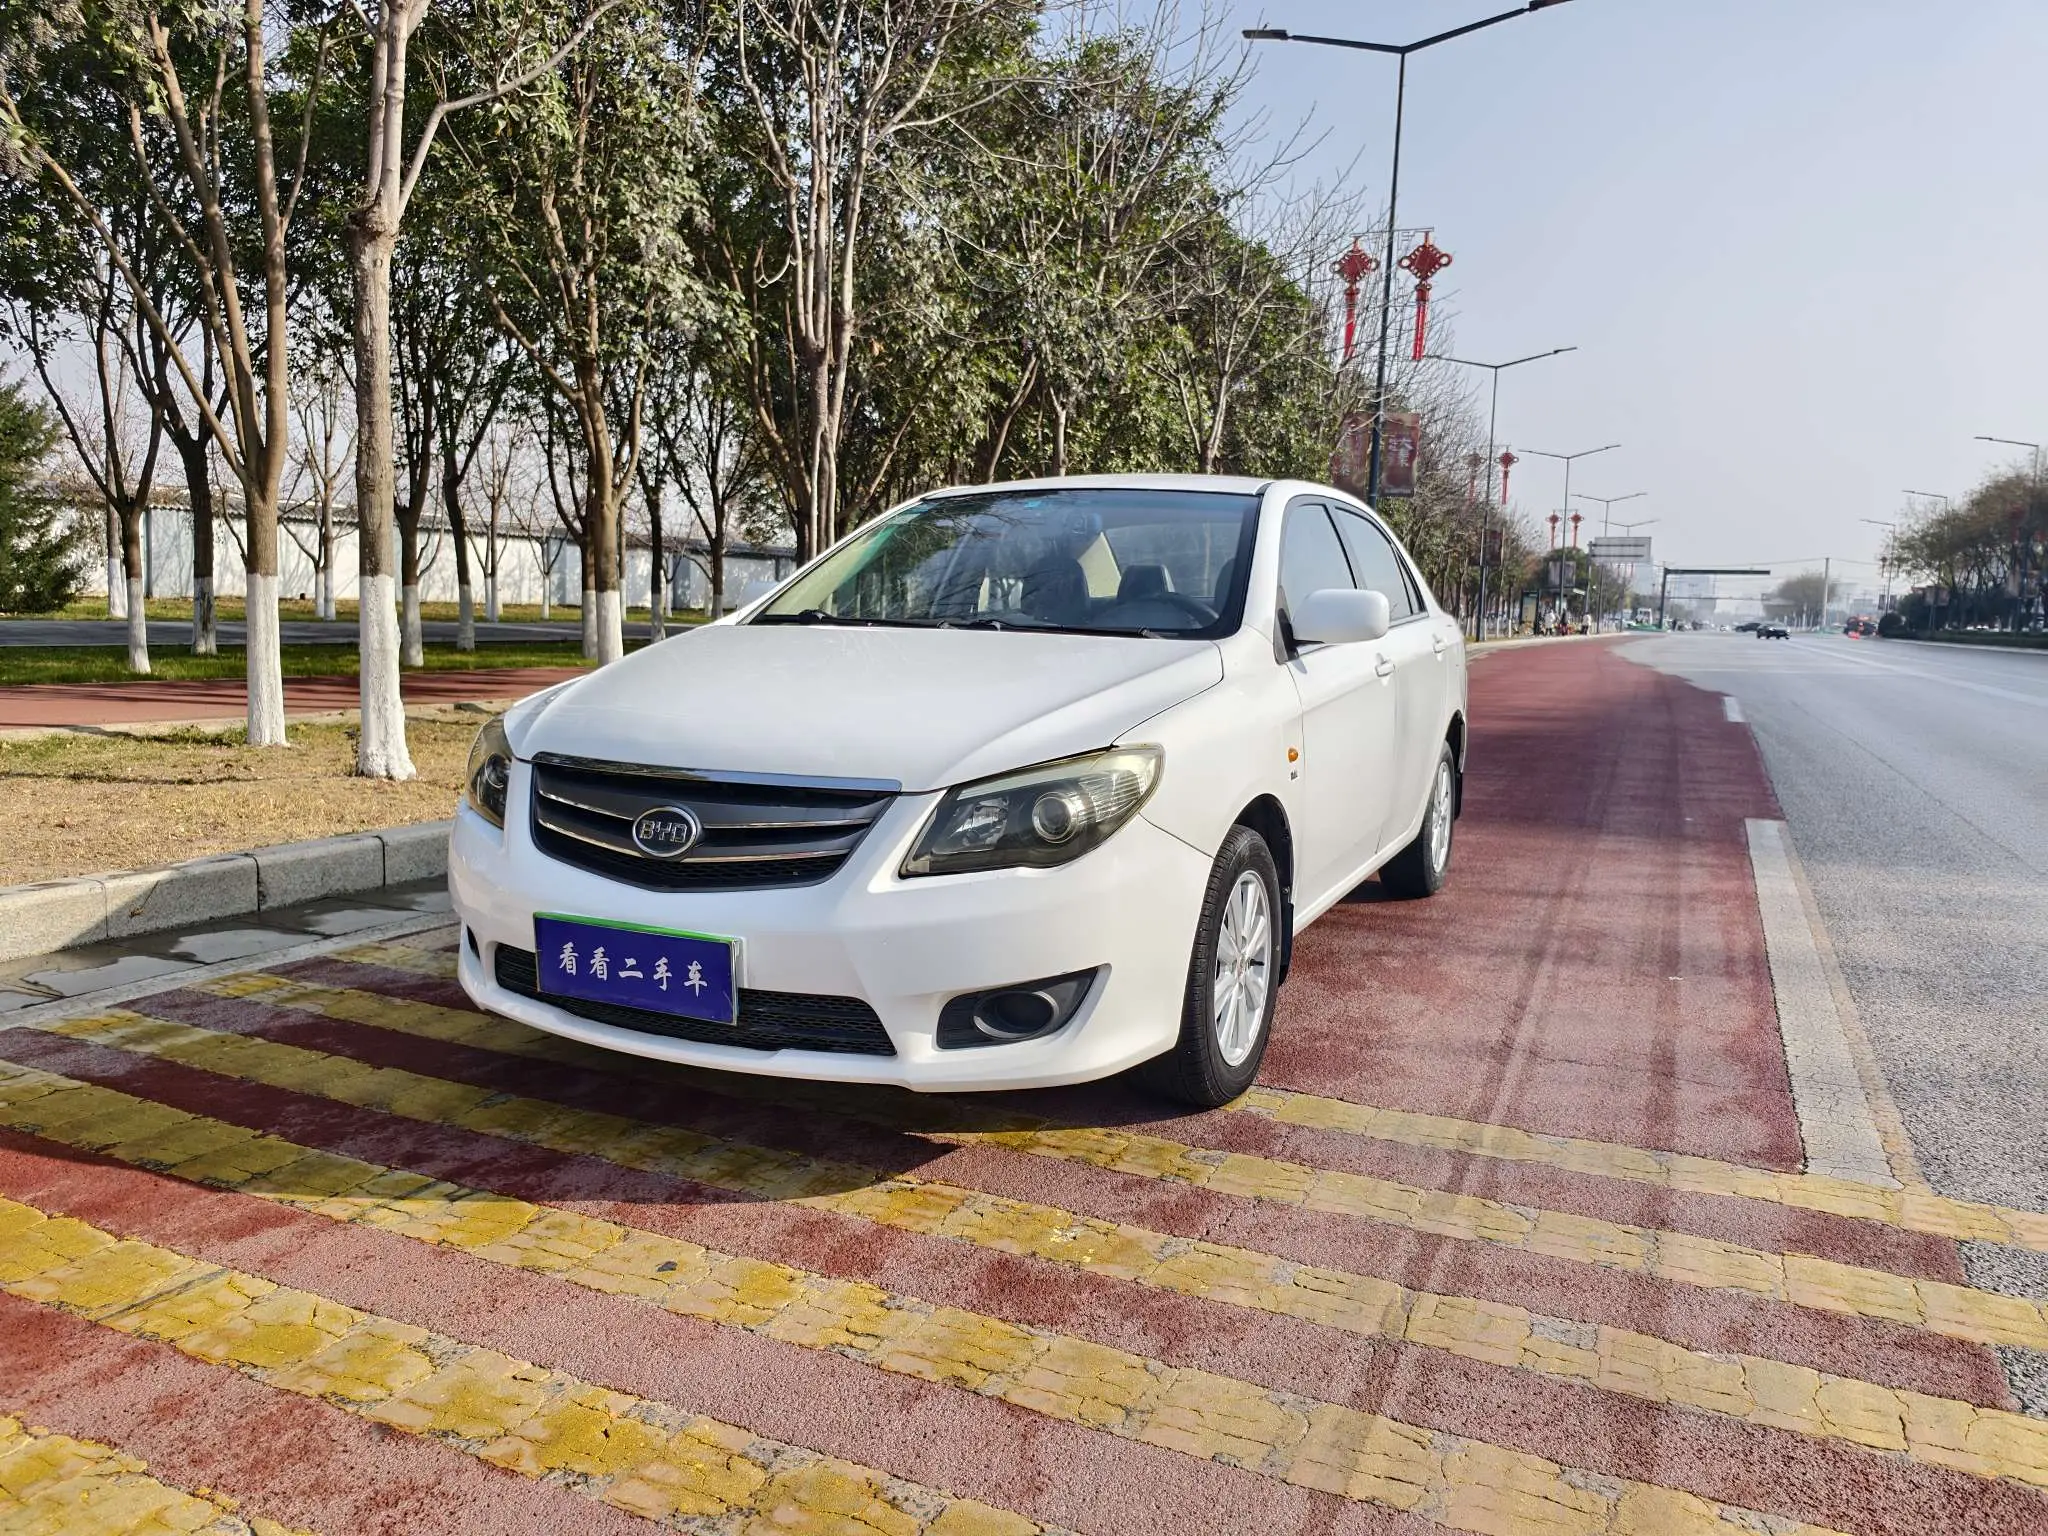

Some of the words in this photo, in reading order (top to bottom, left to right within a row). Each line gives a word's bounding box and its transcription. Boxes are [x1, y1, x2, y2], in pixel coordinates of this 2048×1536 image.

[639, 820, 687, 843] BYD
[559, 941, 708, 998] 看看二手车
